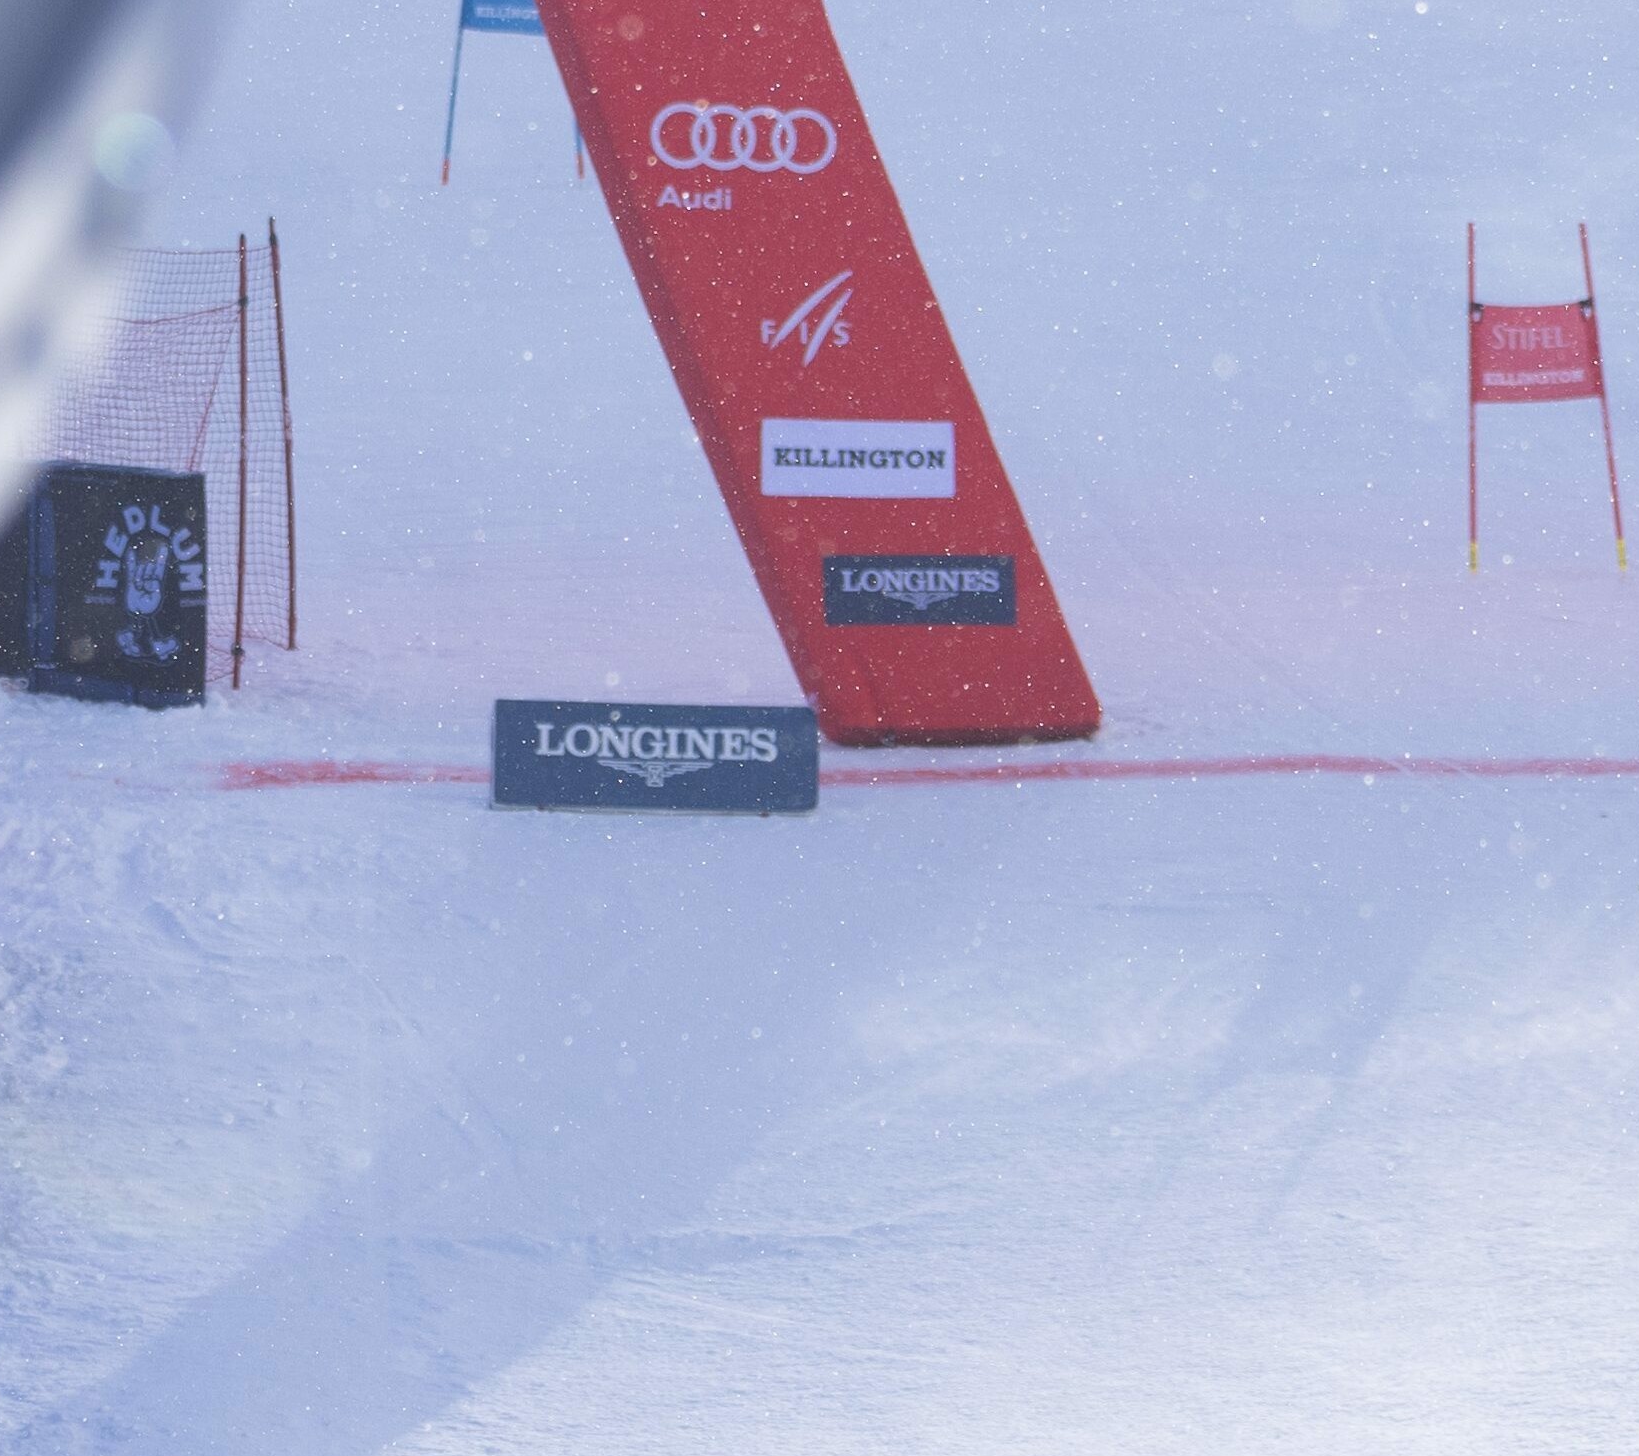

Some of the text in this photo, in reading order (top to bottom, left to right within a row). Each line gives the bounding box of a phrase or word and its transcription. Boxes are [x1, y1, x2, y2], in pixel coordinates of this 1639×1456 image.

[657, 186, 732, 211] Audi
[1491, 325, 1571, 351] STIFEL
[774, 448, 946, 469] KILLINGTON
[841, 569, 1000, 593] LONGINES
[536, 723, 779, 762] LONGINES
